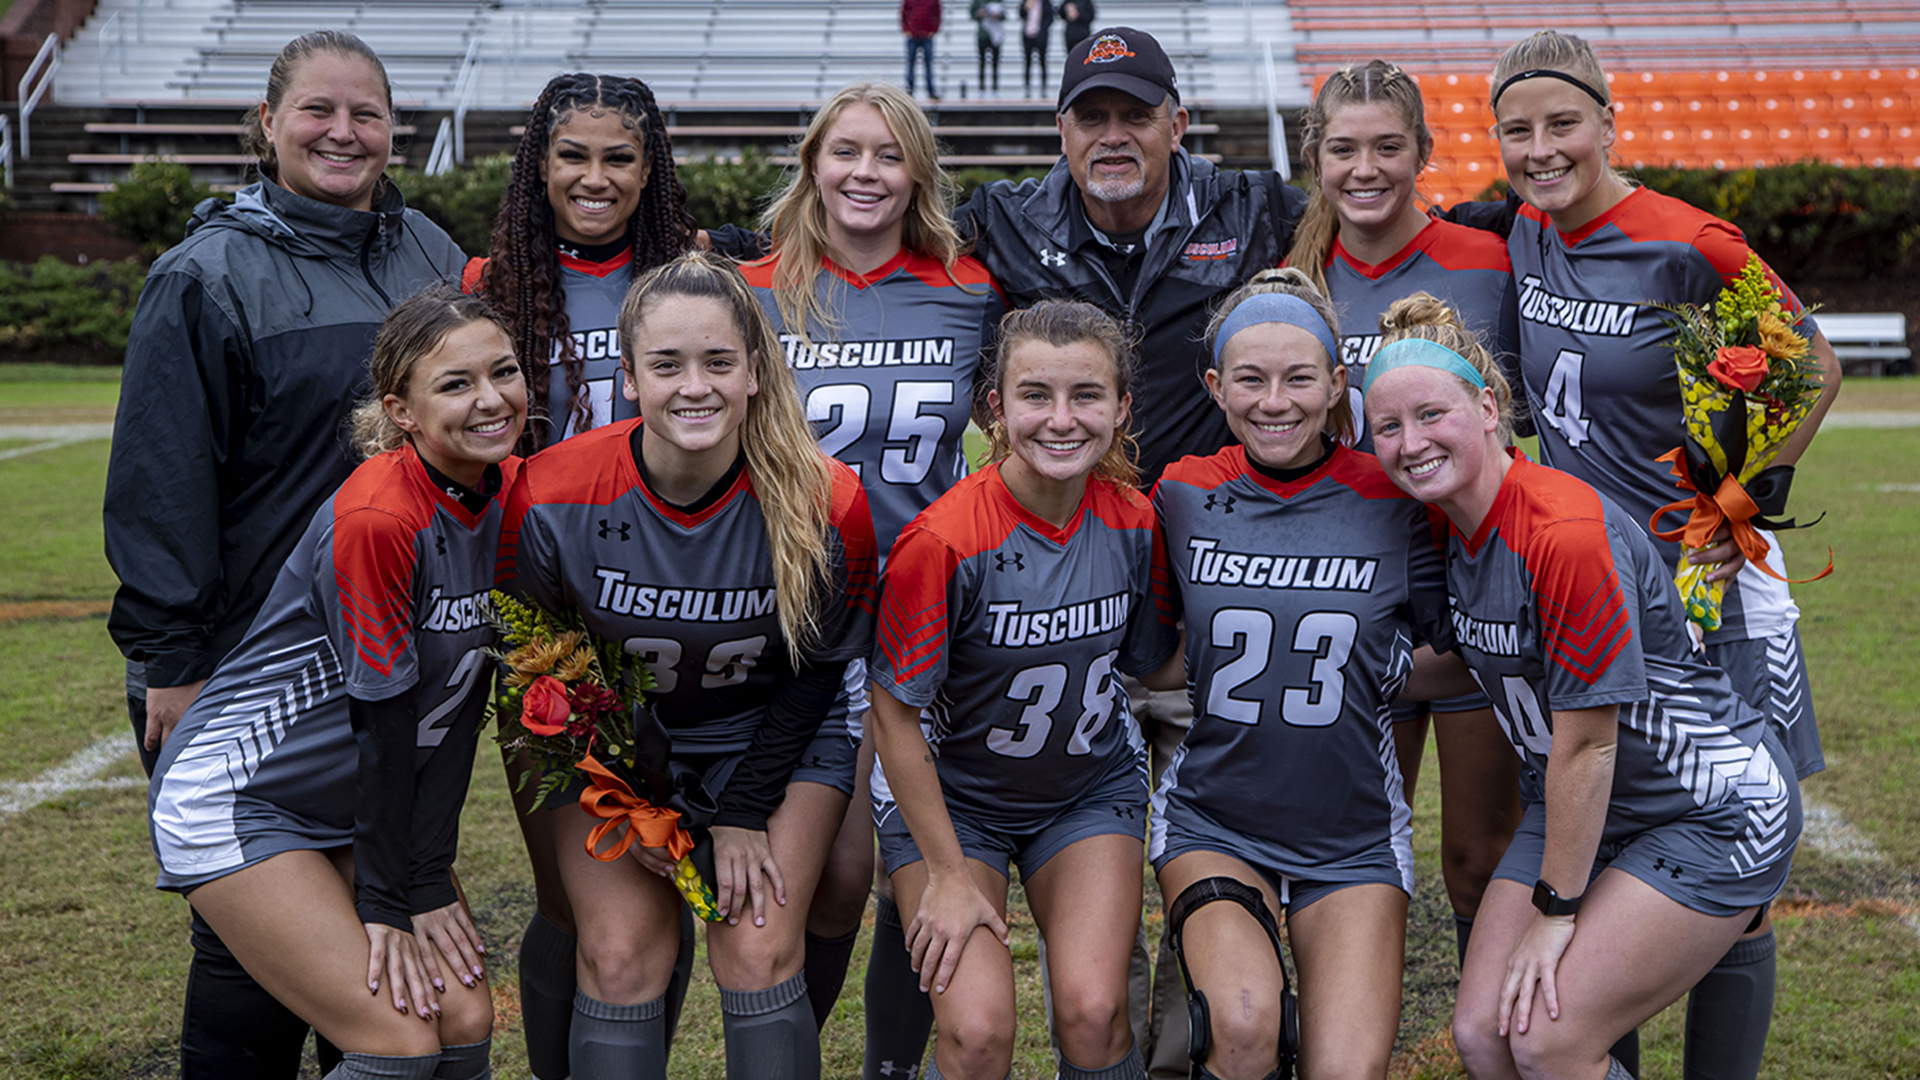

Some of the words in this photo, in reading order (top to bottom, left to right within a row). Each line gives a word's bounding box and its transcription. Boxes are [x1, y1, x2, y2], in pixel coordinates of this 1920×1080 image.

[806, 380, 954, 484] 25
[1541, 349, 1592, 448] 4
[595, 568, 777, 622] TUSCULUM
[1188, 538, 1378, 591] TUSCULUM
[987, 592, 1130, 646] TUSCULUM
[1206, 607, 1360, 728] 23
[416, 646, 488, 748] 2
[985, 648, 1120, 759] 38
